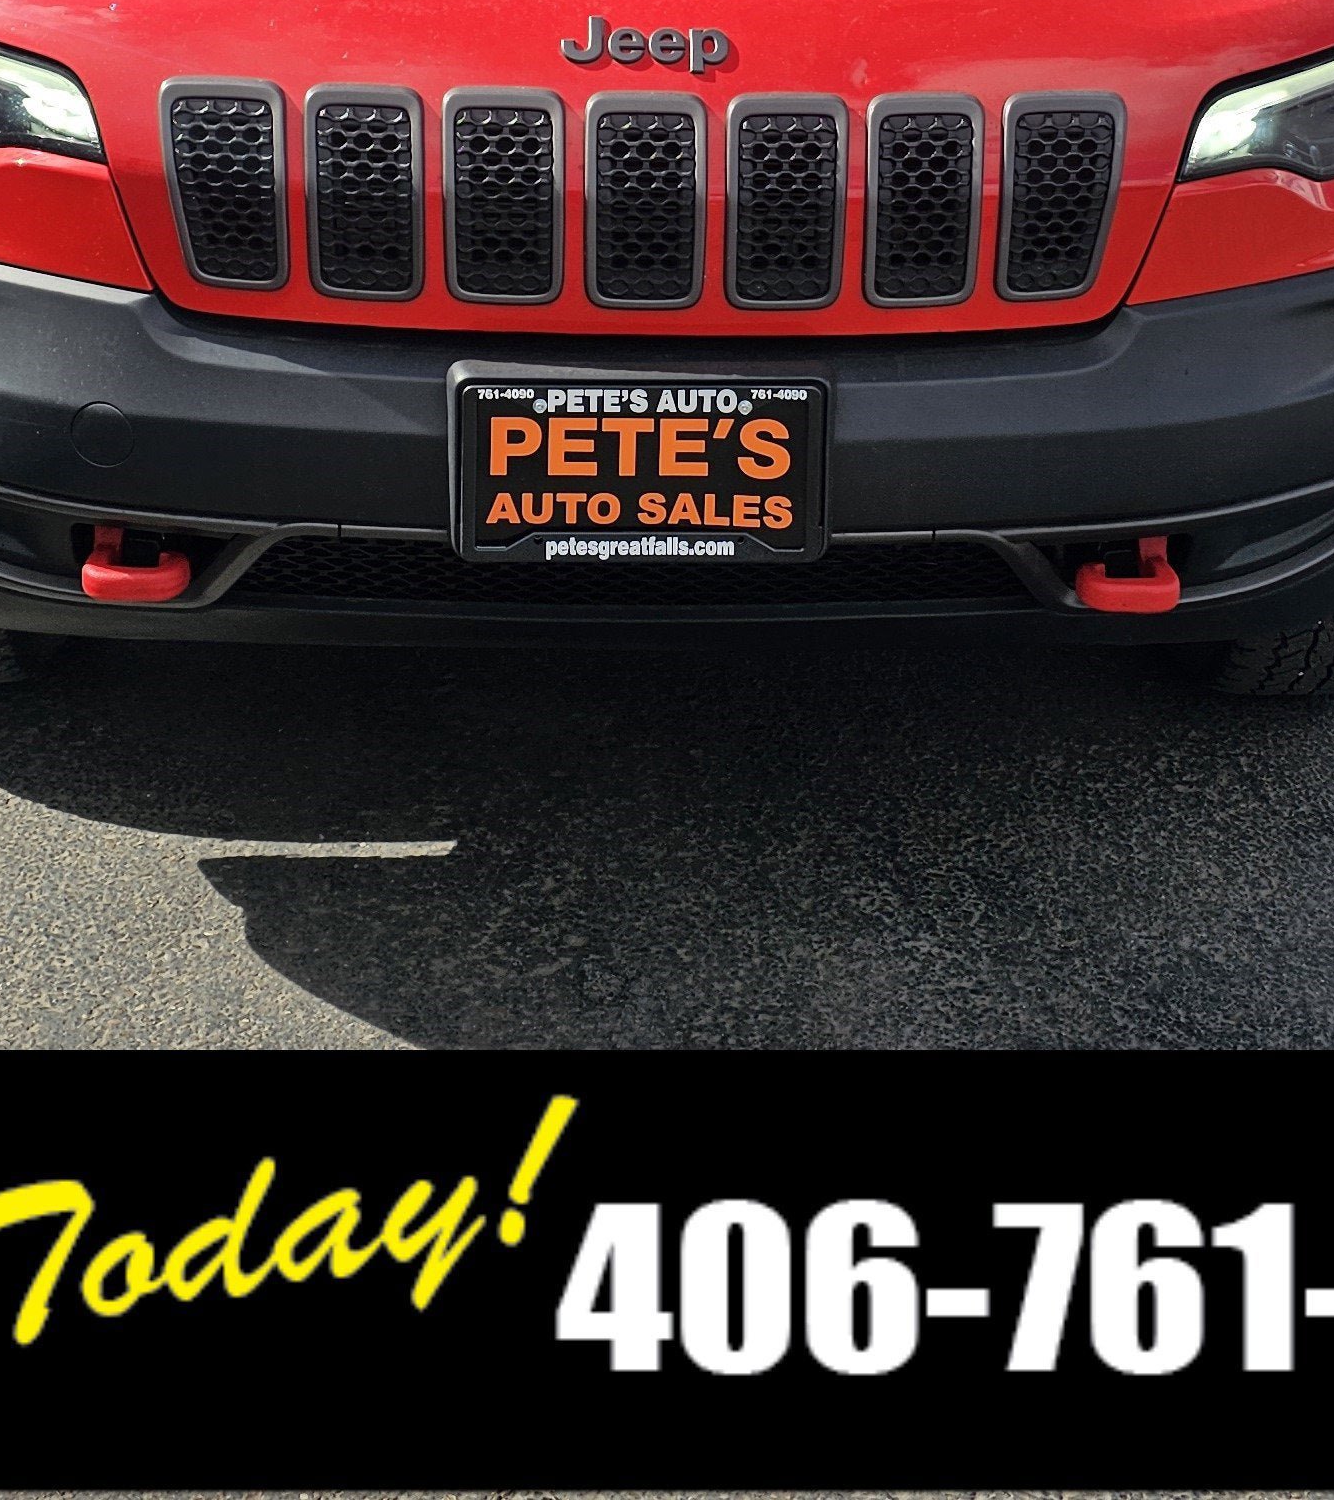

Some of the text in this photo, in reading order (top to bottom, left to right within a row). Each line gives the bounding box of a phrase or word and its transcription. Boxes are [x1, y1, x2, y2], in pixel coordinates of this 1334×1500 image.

[560, 14, 730, 75] Jeep
[477, 388, 535, 400] 761-4090
[546, 388, 738, 414] PETE'S AUTO
[750, 388, 808, 401] 761-4090
[489, 416, 792, 480] PETE'S
[486, 492, 793, 529] AUTO SALES
[545, 536, 735, 560] petesgreatfalls.com
